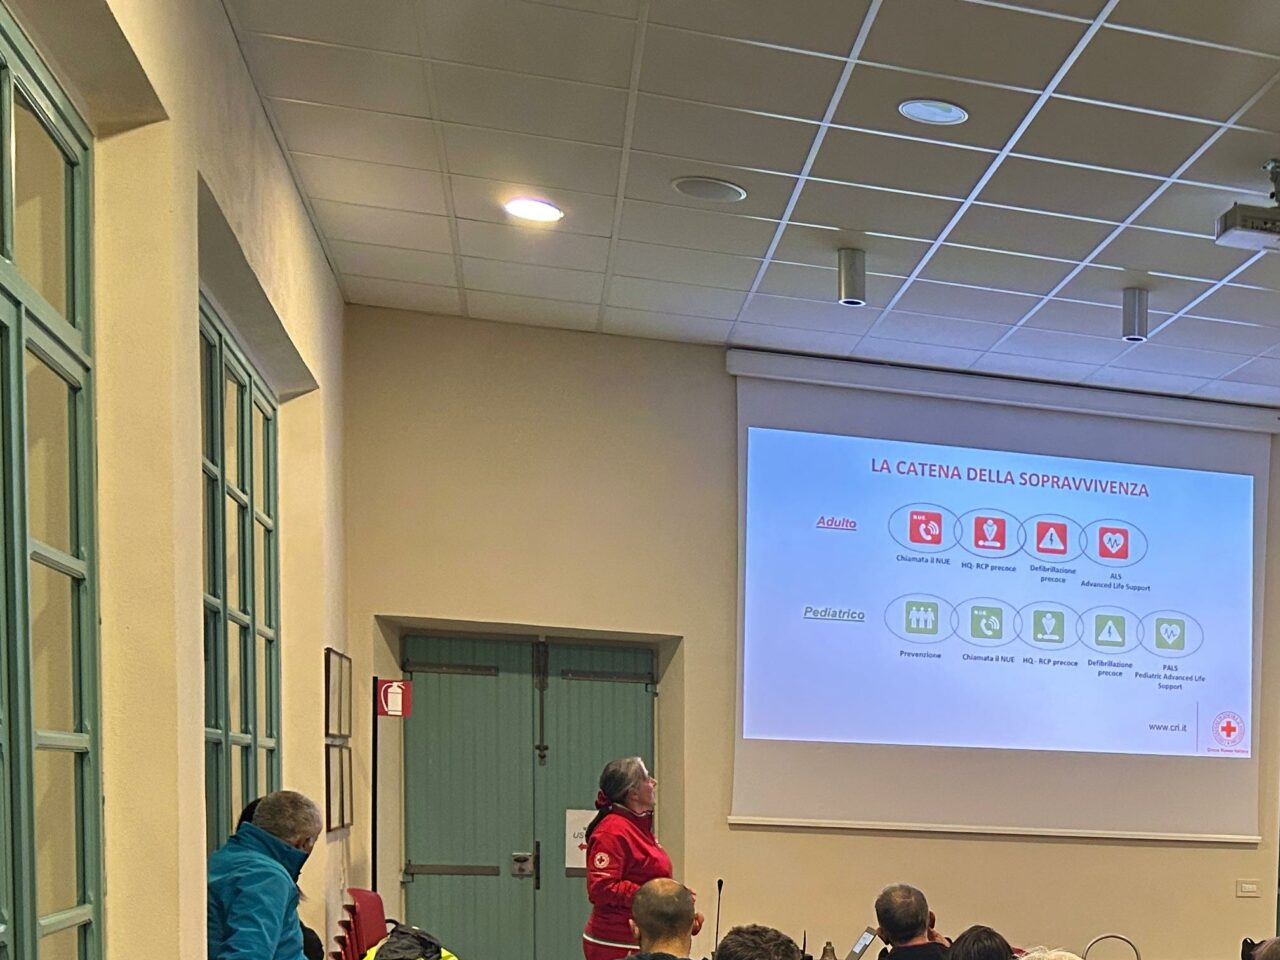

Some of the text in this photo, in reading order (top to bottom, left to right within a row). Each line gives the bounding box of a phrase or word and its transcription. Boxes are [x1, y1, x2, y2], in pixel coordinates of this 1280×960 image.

[871, 458, 1150, 497] LA CATENA DELLA SOPRAVVIVENZA
[816, 516, 857, 529] Adulto
[896, 554, 929, 564] Chiamata
[930, 556, 935, 564] il
[976, 563, 990, 571] RCP
[990, 564, 1017, 572] precoce
[1030, 564, 1077, 575] Defibrillazione
[1040, 576, 1066, 584] precoce
[1110, 573, 1122, 581] ALS
[1081, 580, 1151, 593] Advanced Life Support
[804, 606, 865, 620] Pediatrico
[900, 650, 942, 659] Prevenzione
[962, 653, 994, 662] Chiamata
[1023, 657, 1033, 665] HQ
[1052, 659, 1078, 667] precoce
[1087, 659, 1133, 669] Defibrillazione
[1098, 670, 1123, 678] precoce
[1135, 672, 1162, 680] Pediatric
[1158, 683, 1183, 691] Support
[1149, 723, 1188, 732] www.cri.it
